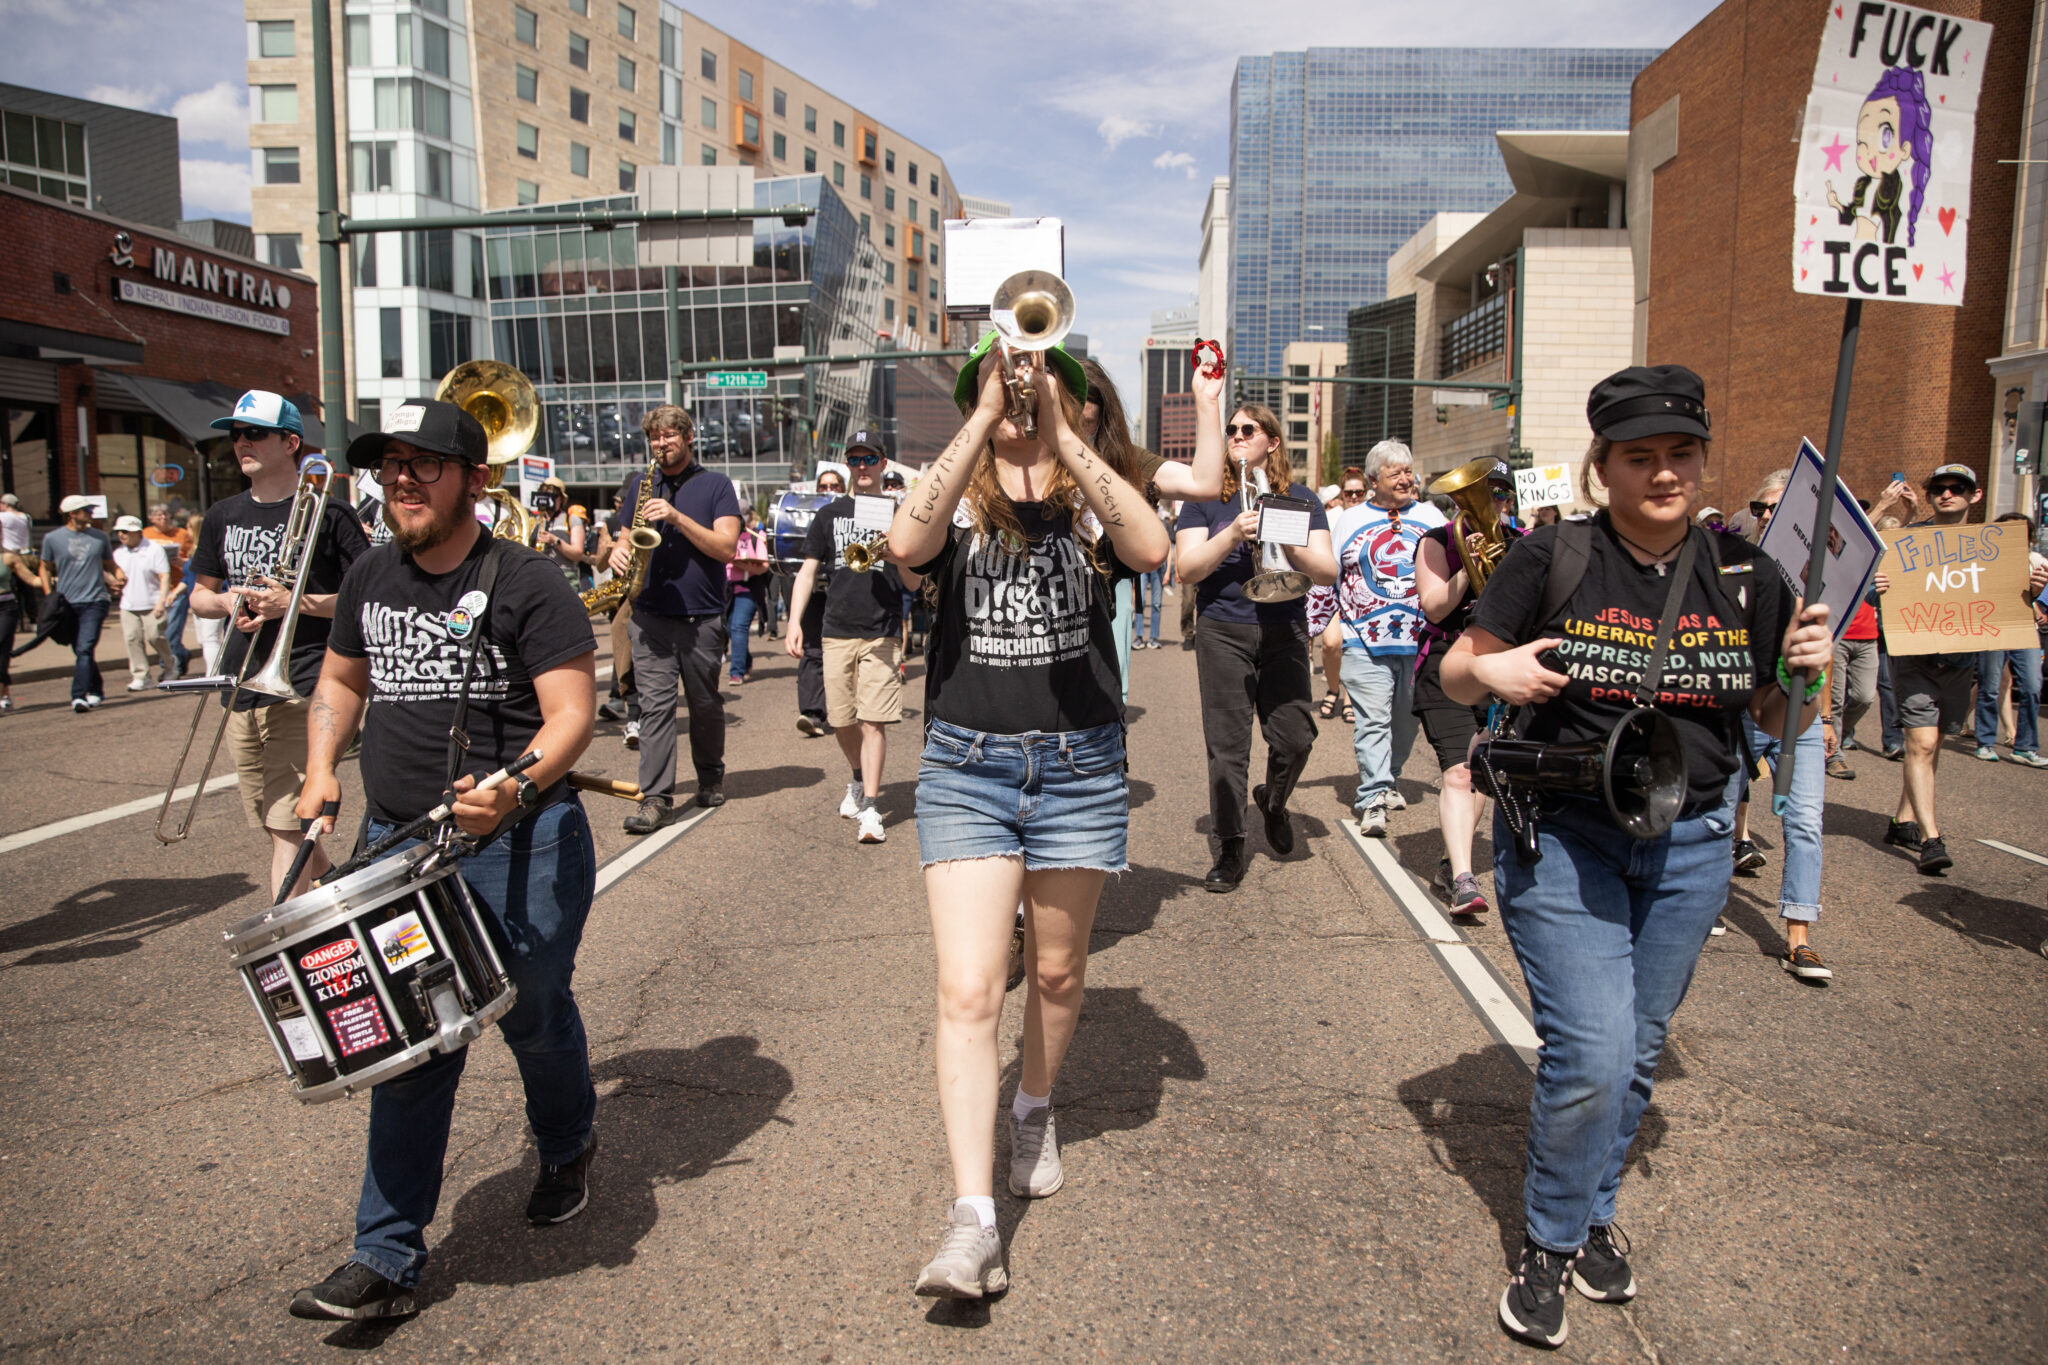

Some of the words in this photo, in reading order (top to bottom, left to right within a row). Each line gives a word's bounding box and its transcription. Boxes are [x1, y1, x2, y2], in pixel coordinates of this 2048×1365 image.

[1849, 2, 1962, 76] FUCK
[156, 247, 275, 307] MANTRA
[1823, 241, 1907, 296] ICE
[137, 287, 174, 306] NEPALI
[178, 298, 213, 315] INDIAN
[215, 305, 249, 323] FUSION
[253, 314, 277, 329] FOOD
[725, 374, 747, 385] 12th
[1518, 471, 1537, 485] NO
[1519, 483, 1570, 506] KINGS
[224, 525, 277, 553] NOTES
[1793, 523, 1813, 551] DEFLE
[1775, 558, 1803, 597] DISTRAC
[1595, 607, 1654, 631] JESUS
[1657, 613, 1702, 632] AS
[1706, 615, 1721, 629] A
[1564, 618, 1675, 650] LIBERATO
[1680, 631, 1709, 648] OF
[1714, 628, 1749, 647] THE
[1699, 651, 1741, 669] NOT
[1566, 661, 1647, 685] MASCO
[1663, 673, 1711, 690] FOR
[1717, 673, 1753, 690] THE
[305, 940, 354, 967] DANGER
[307, 954, 367, 986] ZIONISM
[316, 971, 369, 1002] KILLS!
[338, 1010, 374, 1028] PALESTINE
